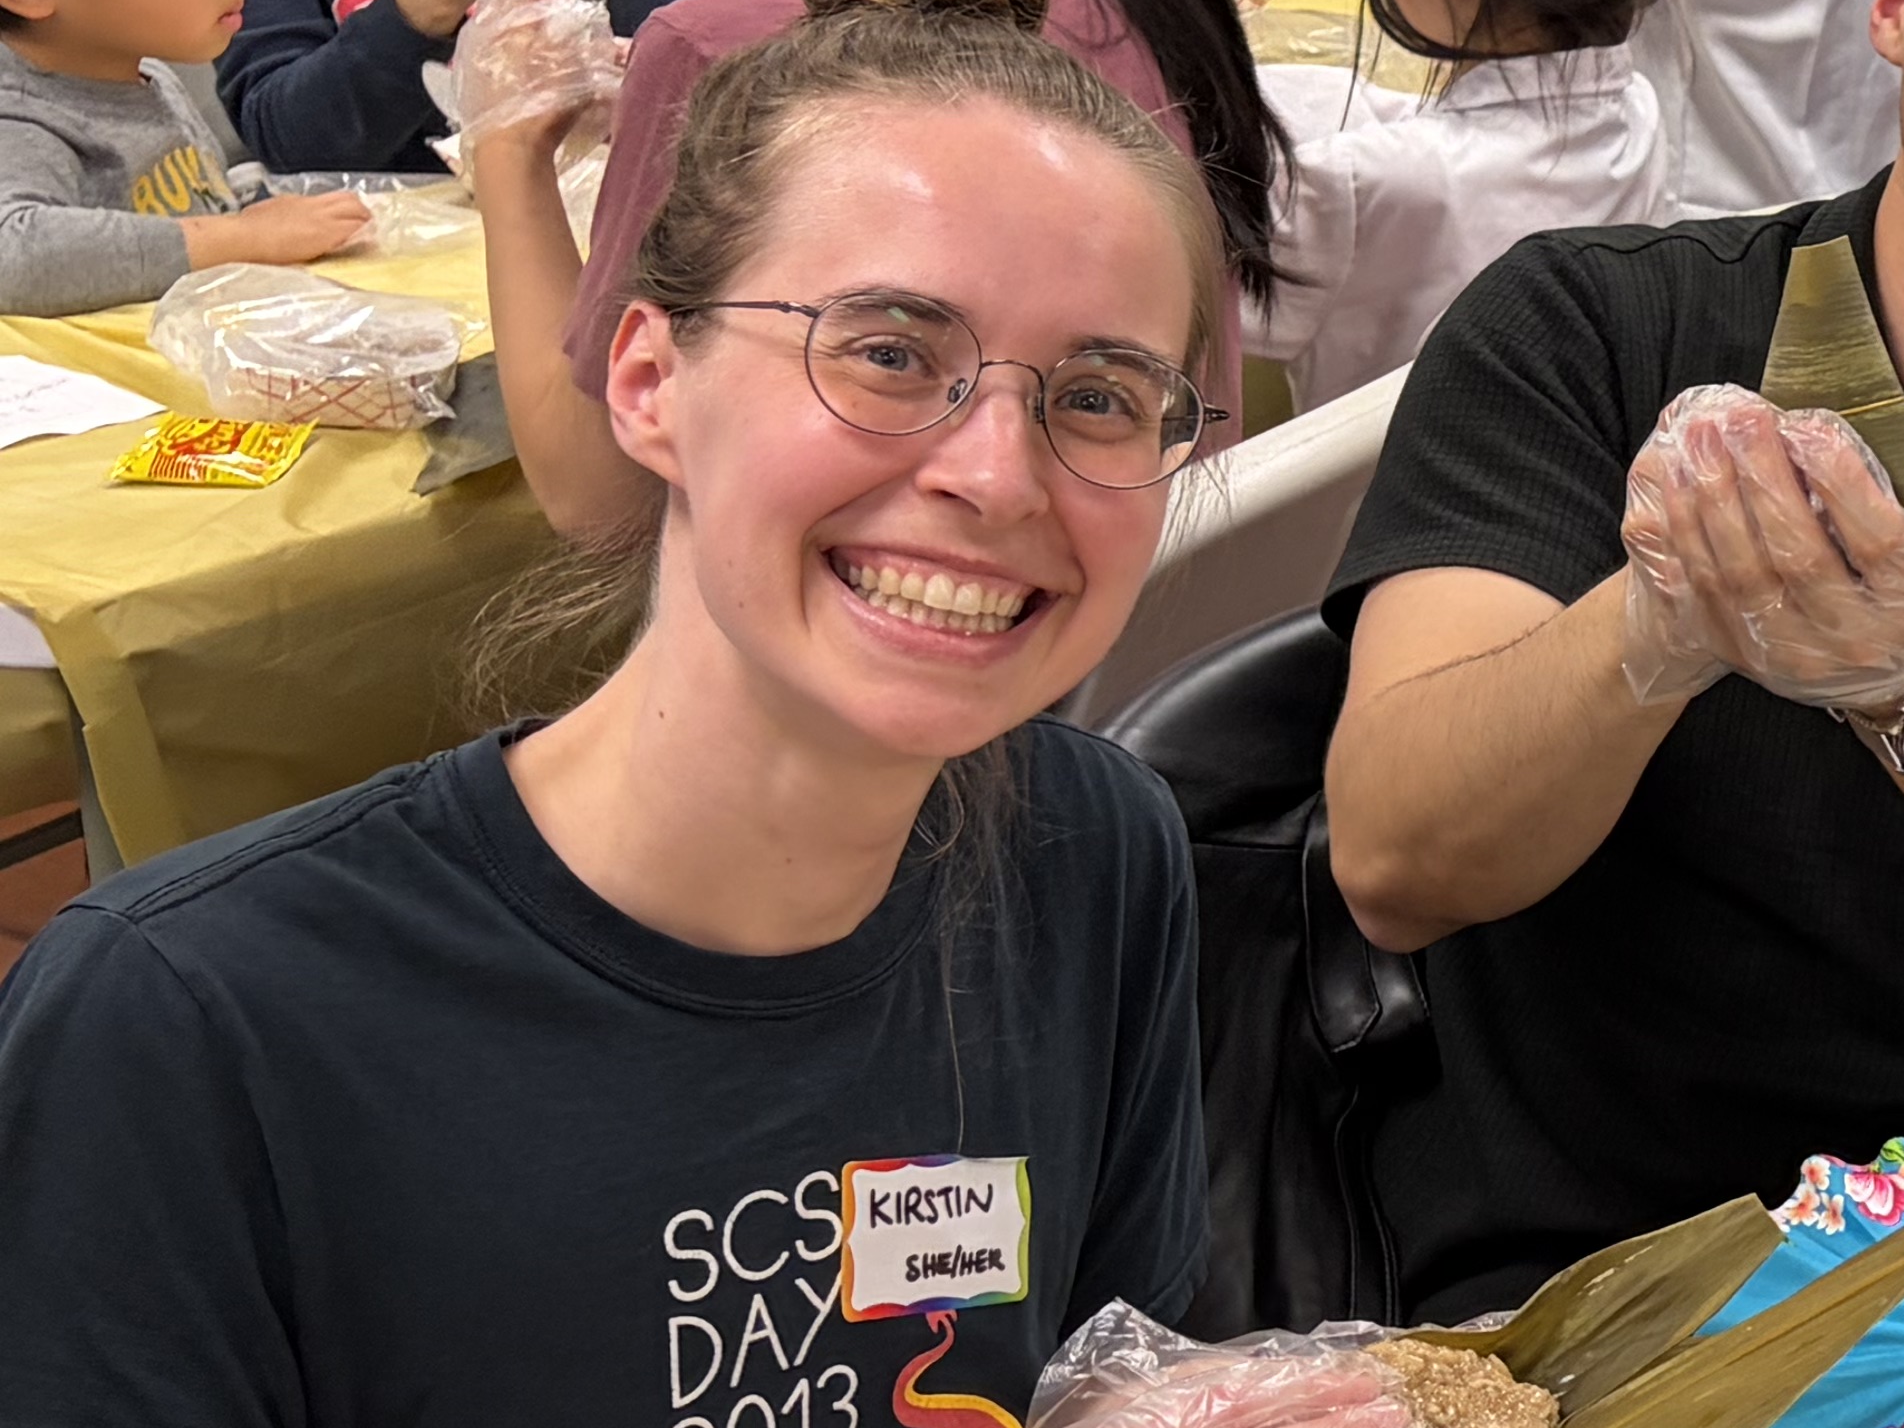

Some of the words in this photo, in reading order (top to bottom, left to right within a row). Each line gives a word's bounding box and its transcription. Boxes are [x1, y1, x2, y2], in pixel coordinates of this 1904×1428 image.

[663, 1170, 843, 1304] SCS
[868, 1182, 995, 1230] KIRSTIN
[904, 1244, 1007, 1283] SHE/HER
[667, 1271, 843, 1409] DAY
